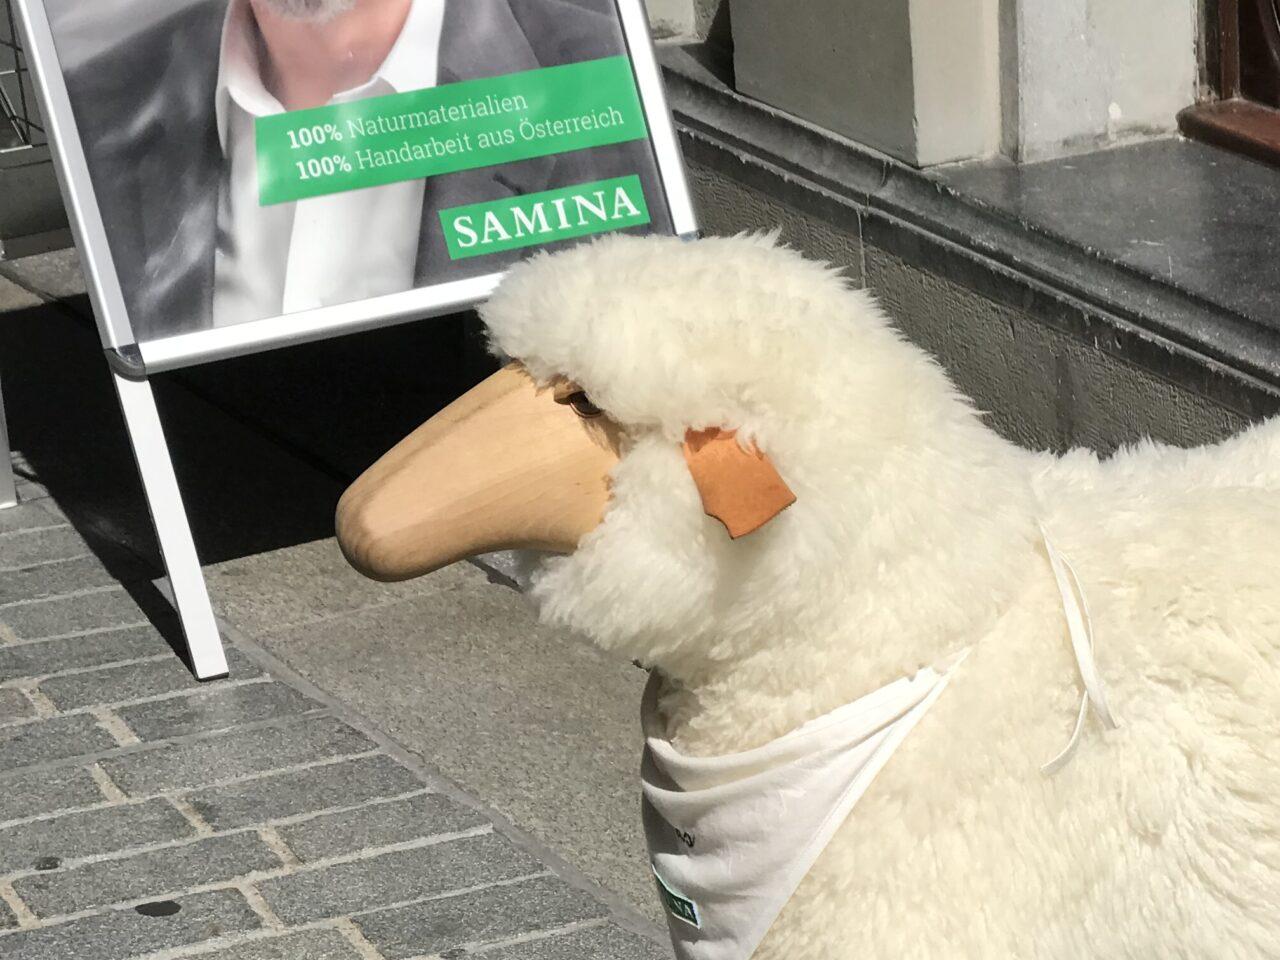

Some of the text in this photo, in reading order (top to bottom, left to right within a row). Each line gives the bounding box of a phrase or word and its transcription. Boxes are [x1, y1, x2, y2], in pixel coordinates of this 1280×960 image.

[287, 93, 528, 149] 100% Naturmaterialien
[296, 106, 625, 180] 100% Handarbeit aus Österreich
[452, 186, 641, 247] SAMINA
